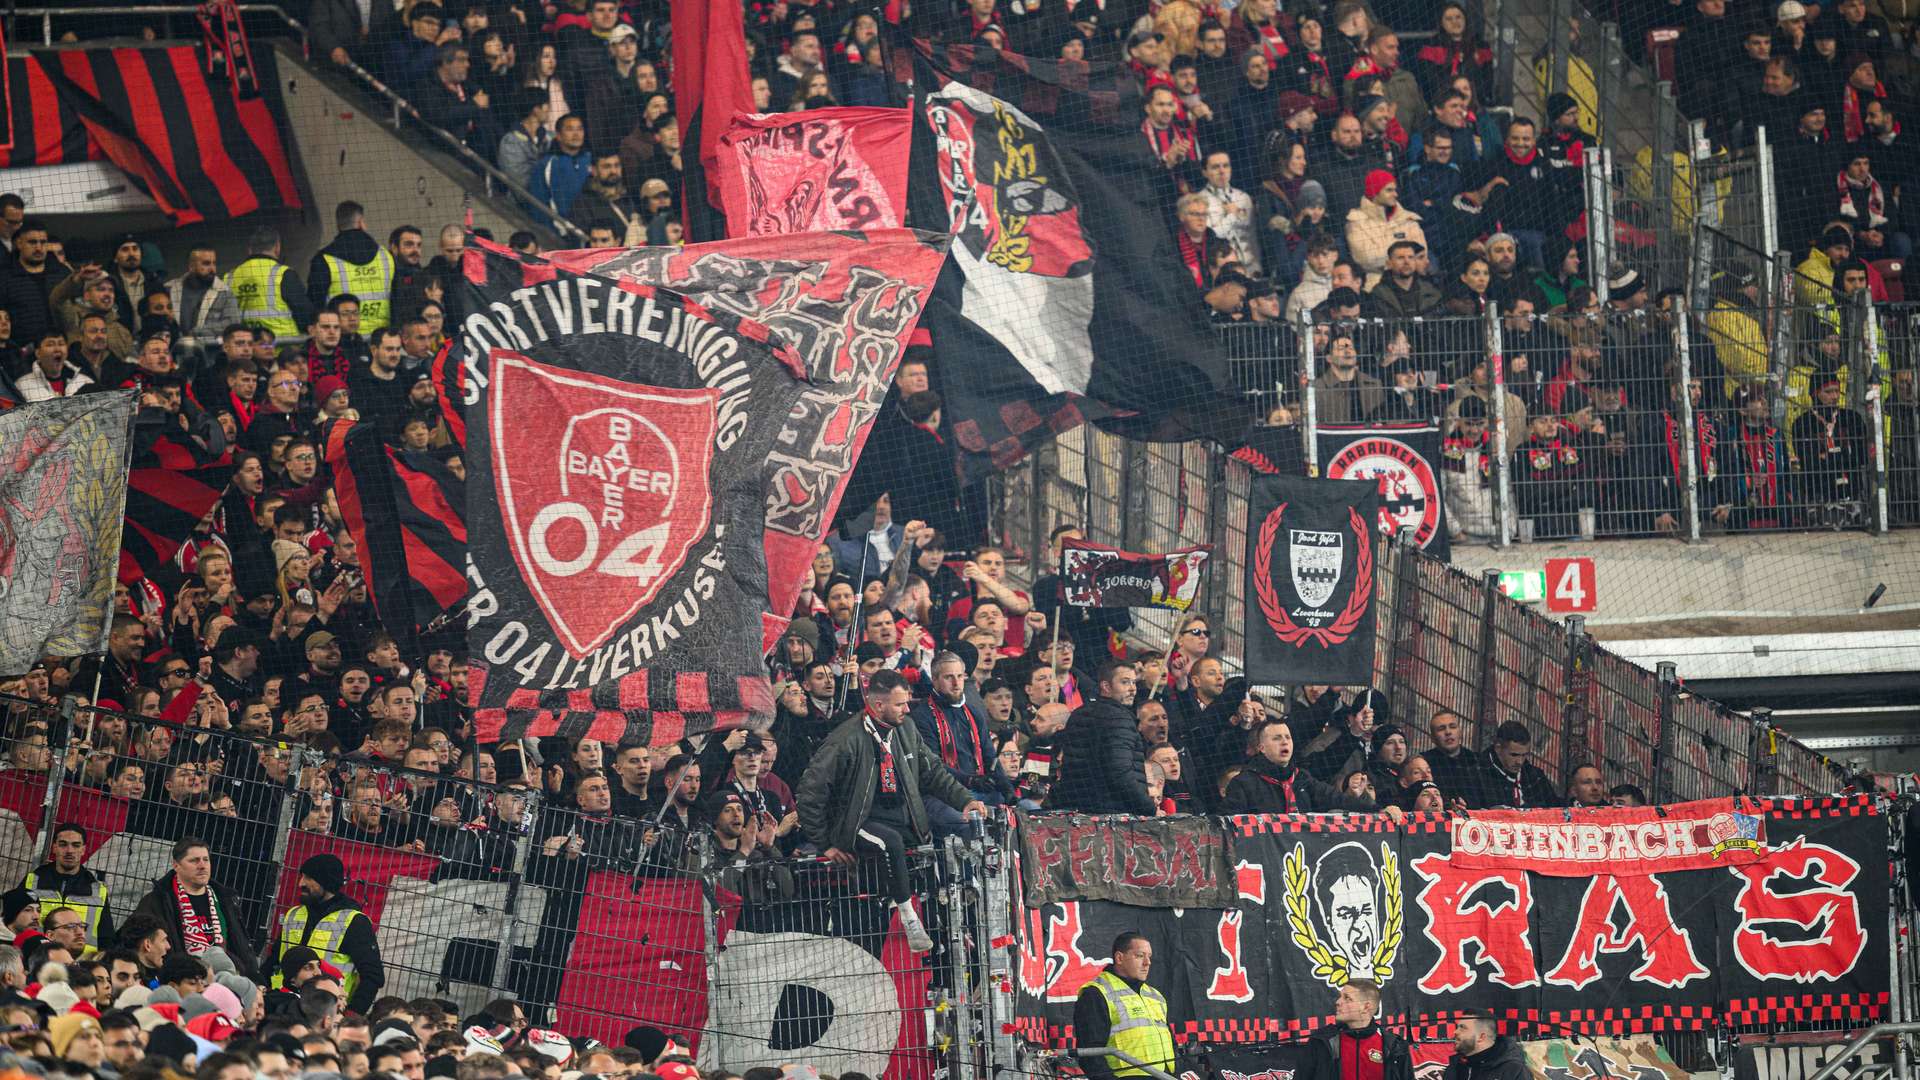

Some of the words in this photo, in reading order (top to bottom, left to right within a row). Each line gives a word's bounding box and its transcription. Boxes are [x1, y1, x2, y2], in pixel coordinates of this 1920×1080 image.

[568, 449, 673, 496] BAYER
[600, 416, 633, 531] BAYER
[528, 501, 672, 587] 04
[484, 619, 552, 686] 04
[543, 523, 726, 690] LEVERKUSE
[1555, 562, 1586, 608] 4
[1458, 818, 1699, 862] OFFENBACH
